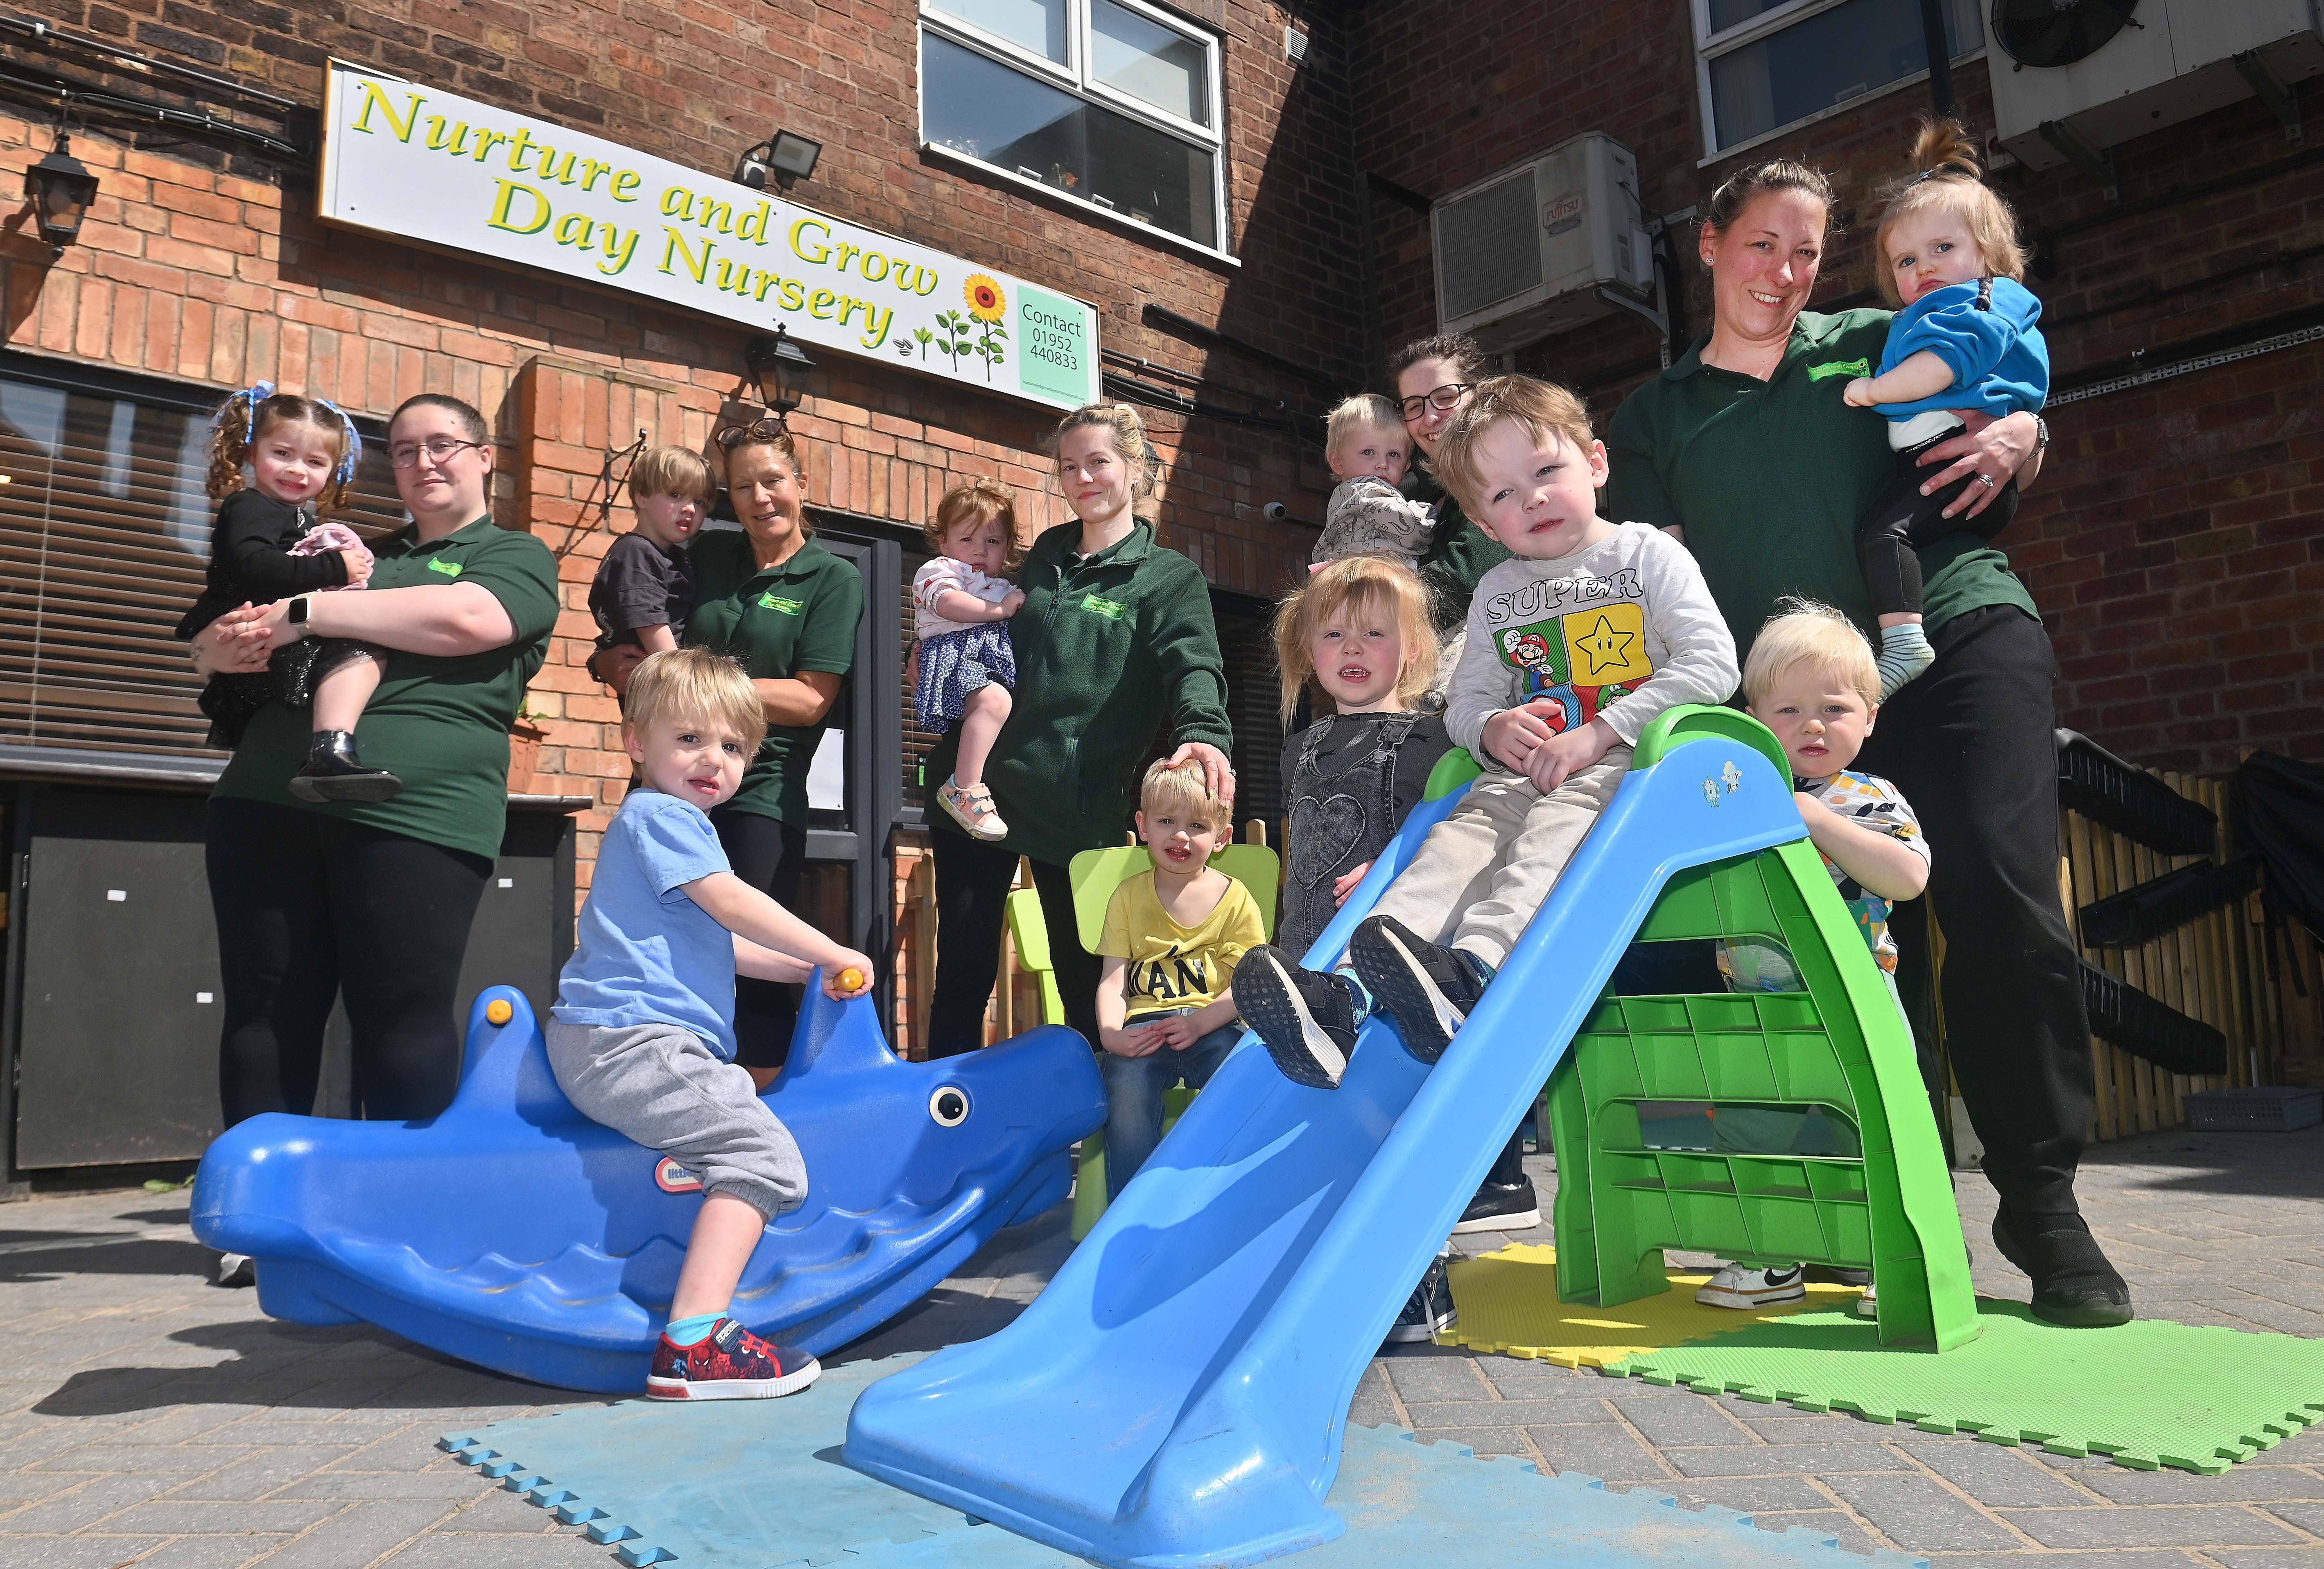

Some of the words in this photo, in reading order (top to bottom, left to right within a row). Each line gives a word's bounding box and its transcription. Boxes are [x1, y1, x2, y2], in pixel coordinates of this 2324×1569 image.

[350, 79, 641, 202] Nurture
[659, 185, 771, 246] and
[788, 218, 938, 296] Grow
[1547, 199, 1578, 221] FUJITSU
[485, 176, 640, 276] Day
[656, 224, 894, 349] Nursery
[1023, 304, 1081, 337] Contact
[1033, 328, 1072, 352] 01952
[1030, 345, 1077, 370] 440833
[1487, 568, 1643, 624] SUPER
